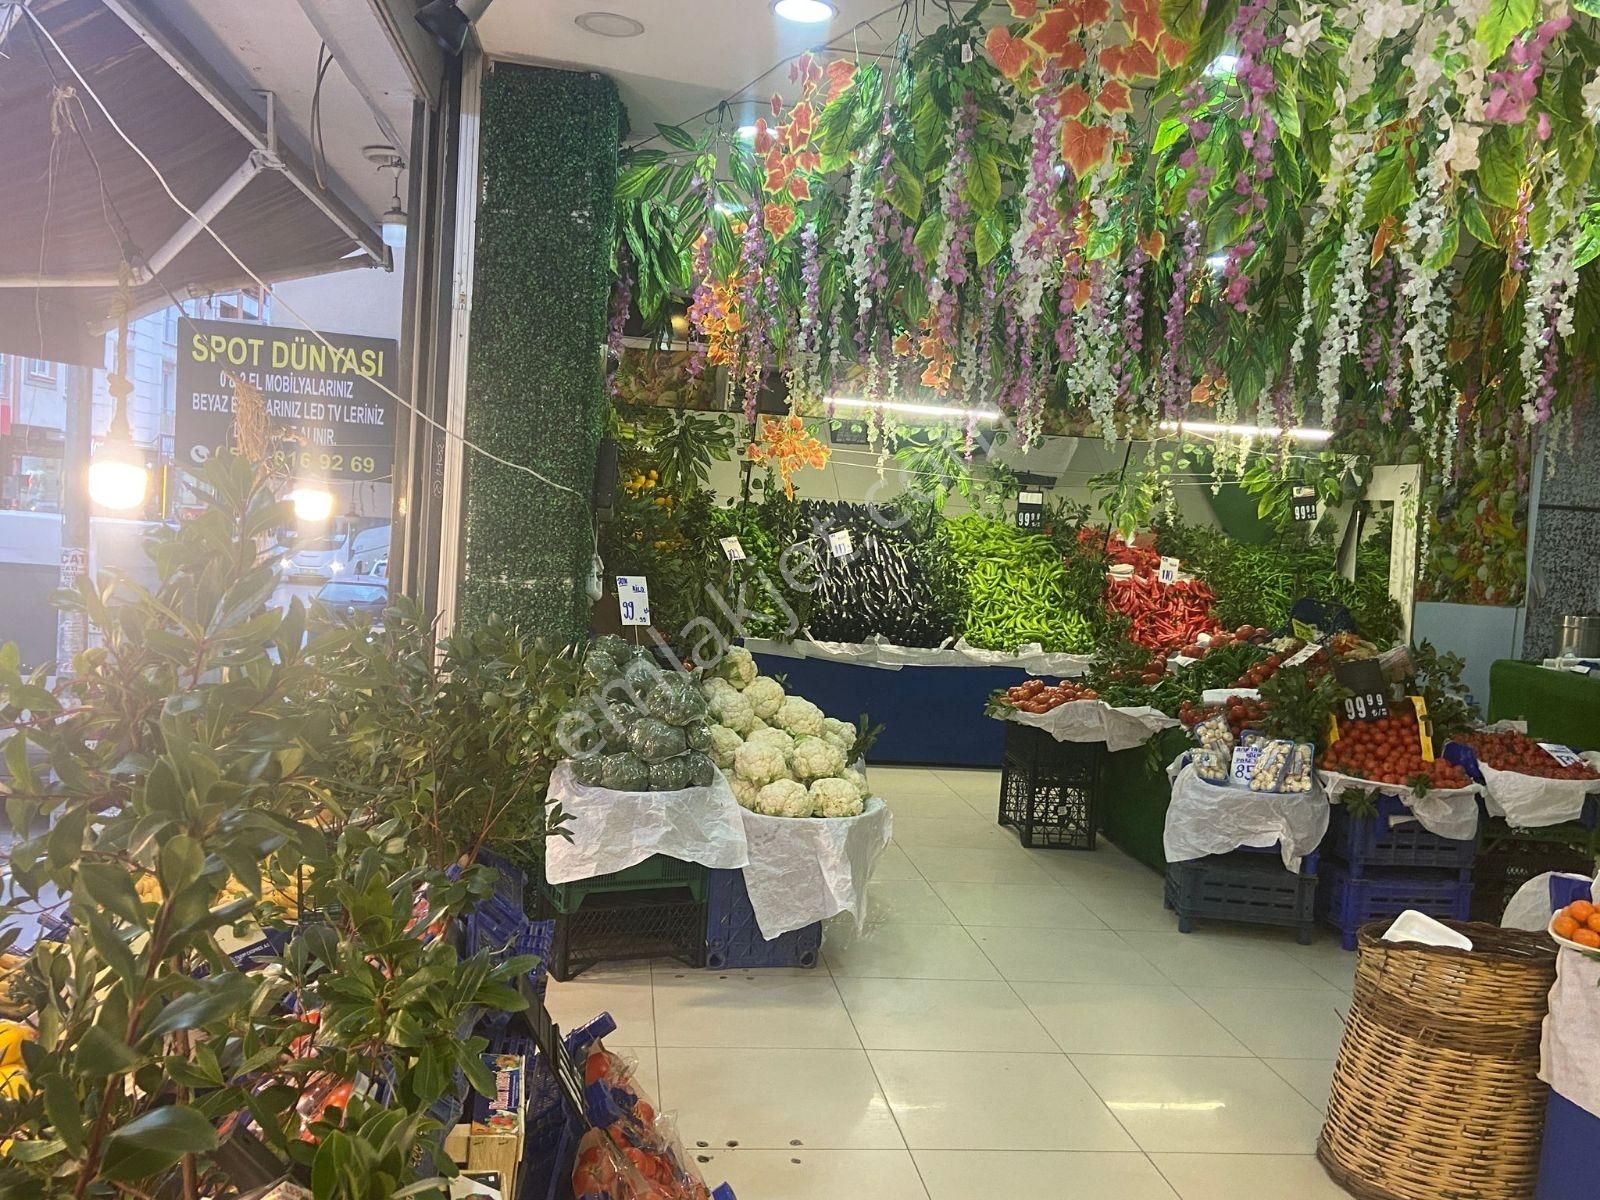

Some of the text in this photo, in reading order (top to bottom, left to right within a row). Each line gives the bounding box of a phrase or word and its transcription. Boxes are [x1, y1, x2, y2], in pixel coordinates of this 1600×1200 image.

[191, 333, 384, 378] SPOT DÜNYASI
[265, 371, 354, 399] MOBİLYALARINIZ
[192, 392, 385, 426] BEYAZ EARINIZ LED TV LERİNİZ
[319, 453, 344, 472] 92
[350, 456, 375, 474] 69
[622, 601, 635, 621] 99
[1344, 695, 1367, 720] 99
